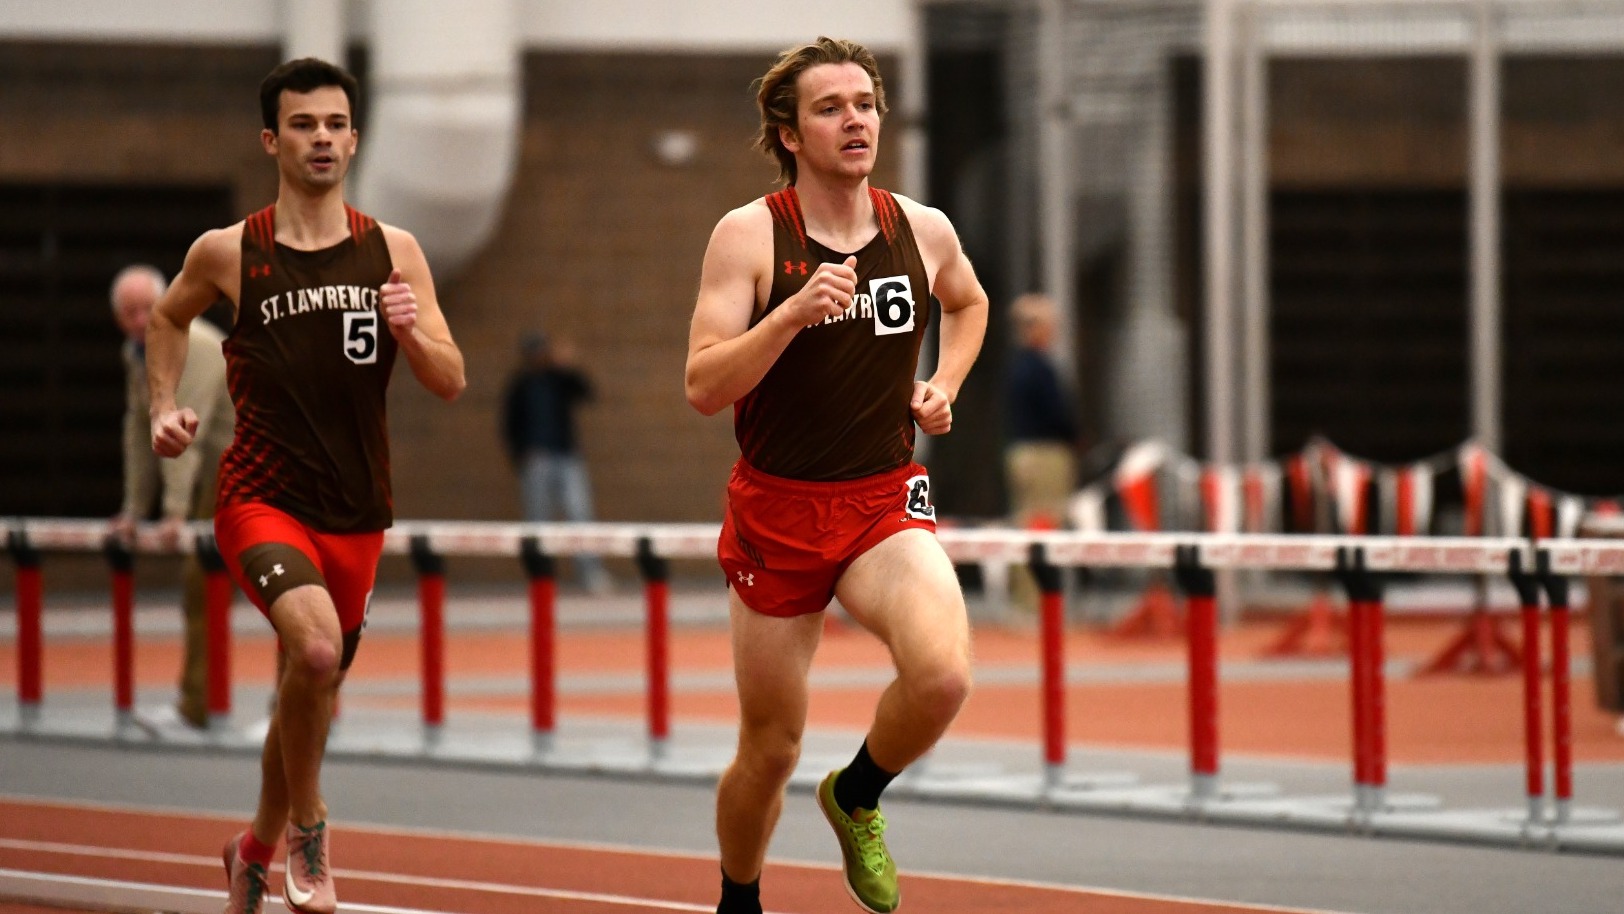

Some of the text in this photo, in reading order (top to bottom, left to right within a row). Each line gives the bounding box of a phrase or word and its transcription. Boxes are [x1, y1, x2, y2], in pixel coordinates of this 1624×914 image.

[260, 285, 379, 326] ST. LAWRENCE
[875, 281, 912, 329] 6
[346, 318, 376, 360] 5
